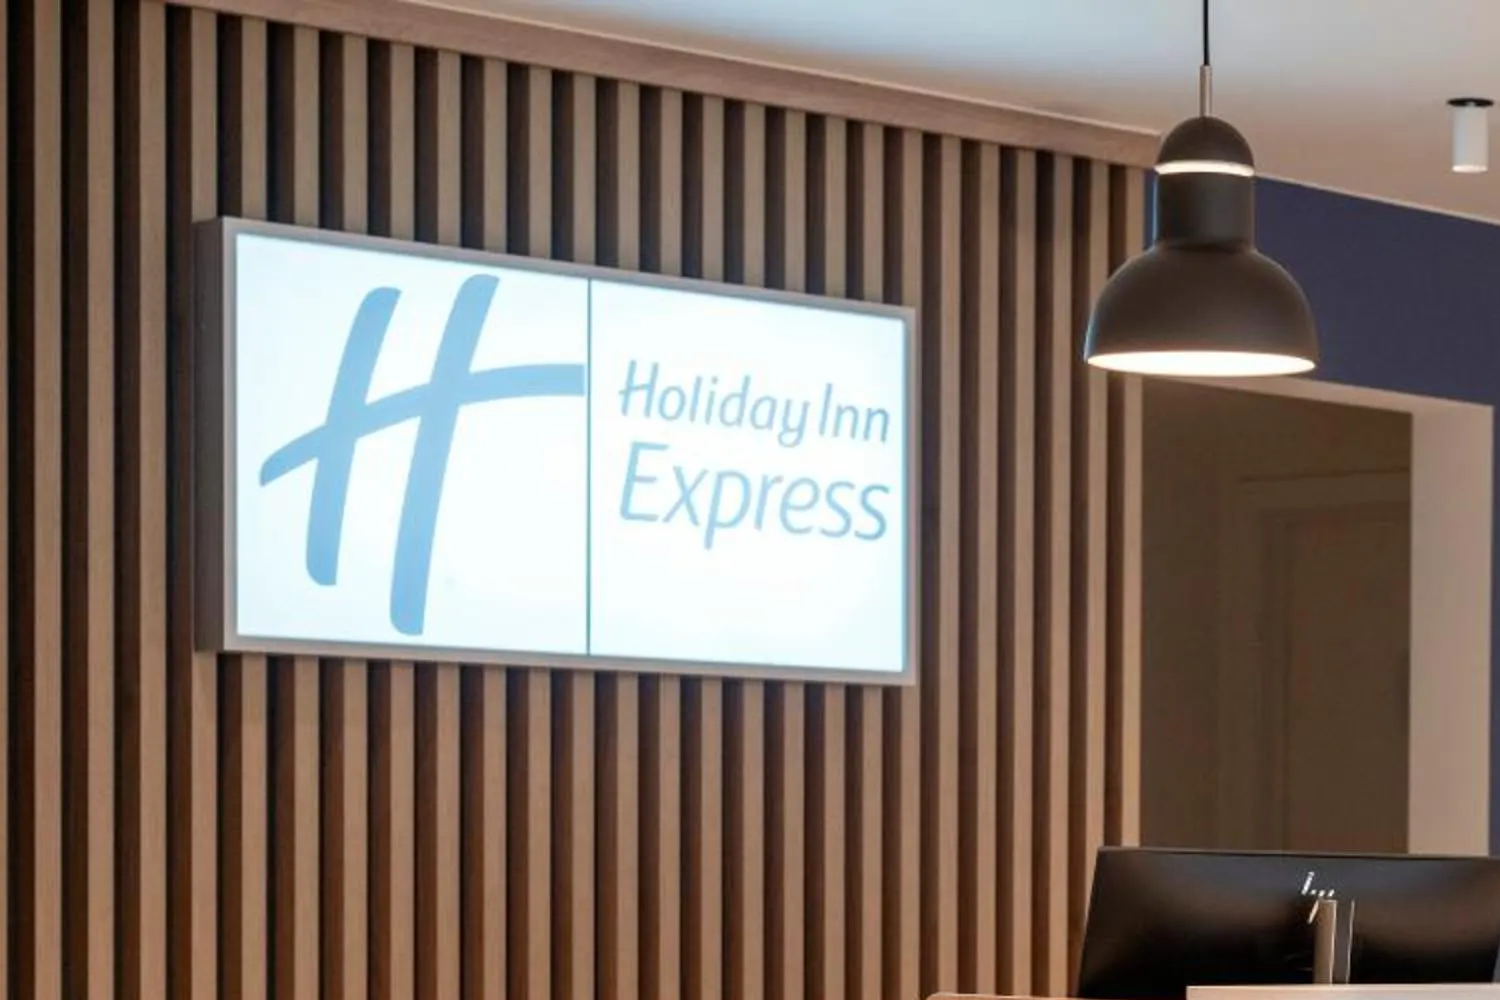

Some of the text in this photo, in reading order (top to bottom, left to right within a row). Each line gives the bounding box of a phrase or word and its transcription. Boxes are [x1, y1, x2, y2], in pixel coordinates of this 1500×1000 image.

[618, 359, 890, 448] Holiday Inn
[619, 441, 891, 550] Express
